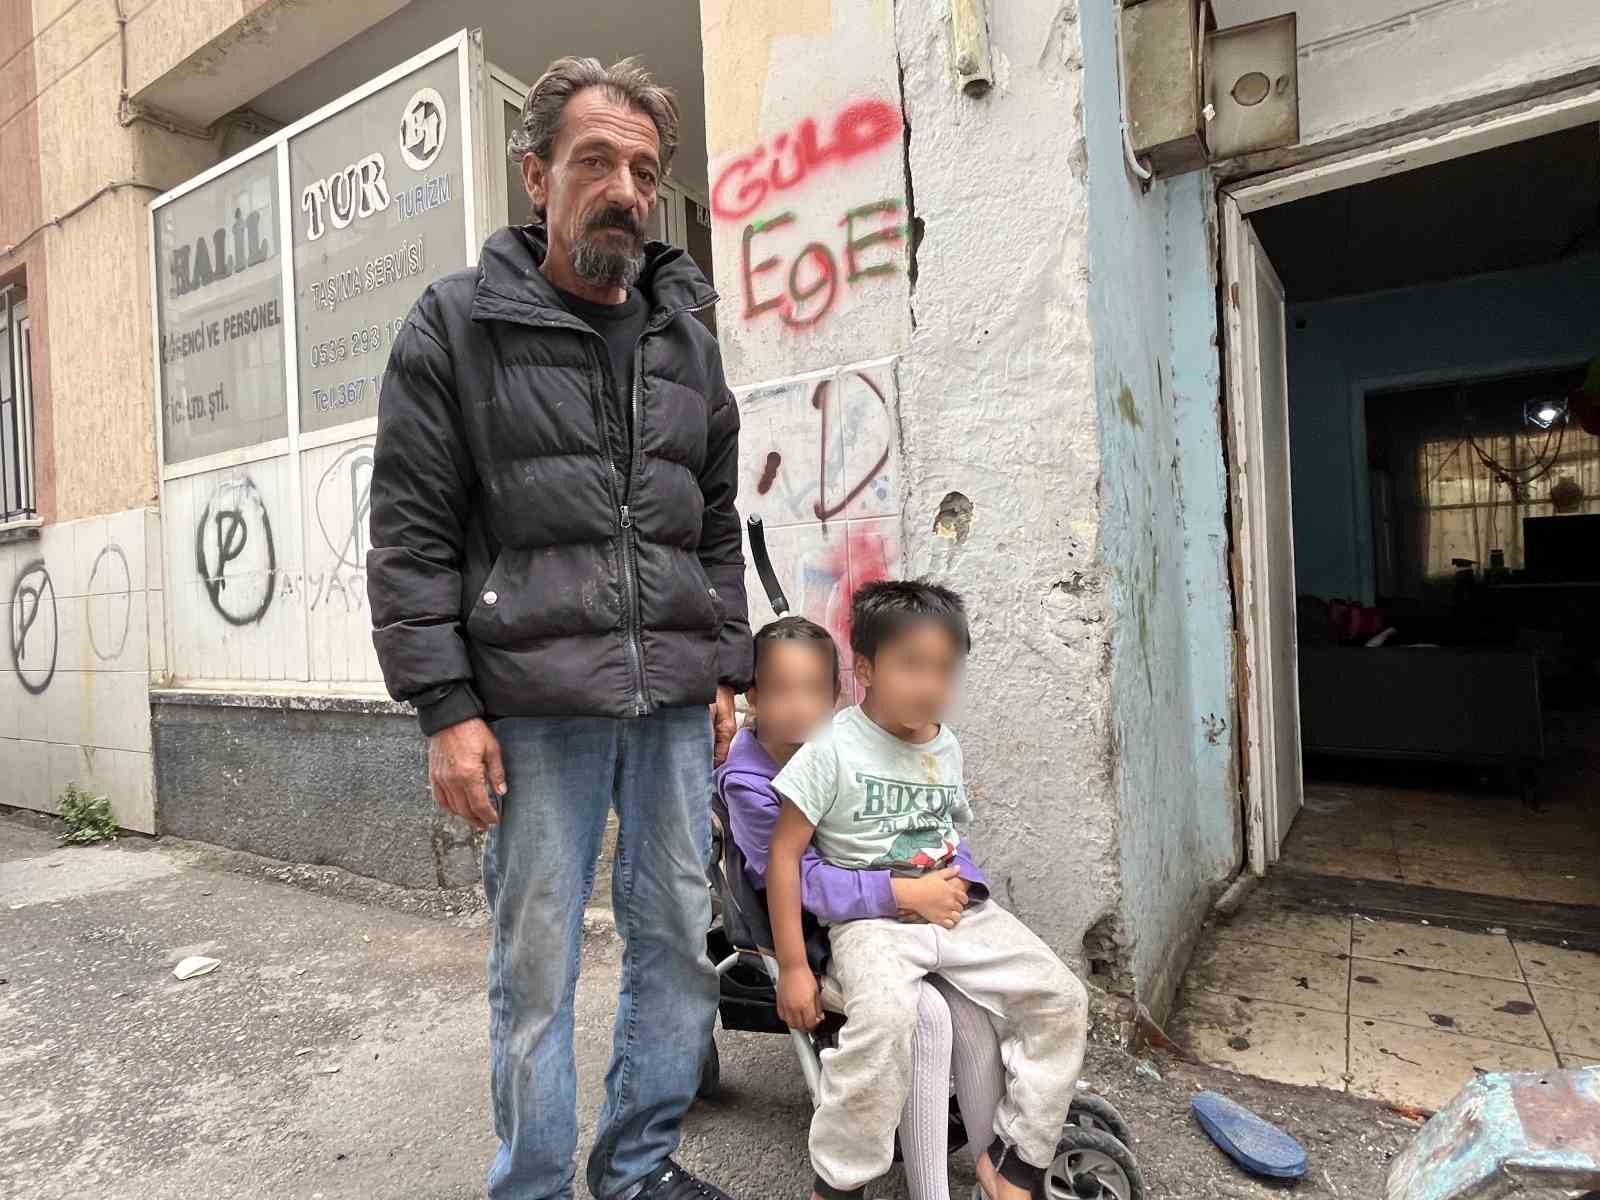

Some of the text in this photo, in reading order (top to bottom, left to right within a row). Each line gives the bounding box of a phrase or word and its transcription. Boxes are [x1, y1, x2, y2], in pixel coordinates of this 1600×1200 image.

[302, 152, 391, 241] TUR
[395, 173, 452, 221] TURİZM
[365, 234, 425, 291] SERVİSİ
[206, 321, 220, 349] VE
[223, 298, 281, 343] PERSONEL
[351, 324, 381, 357] 293
